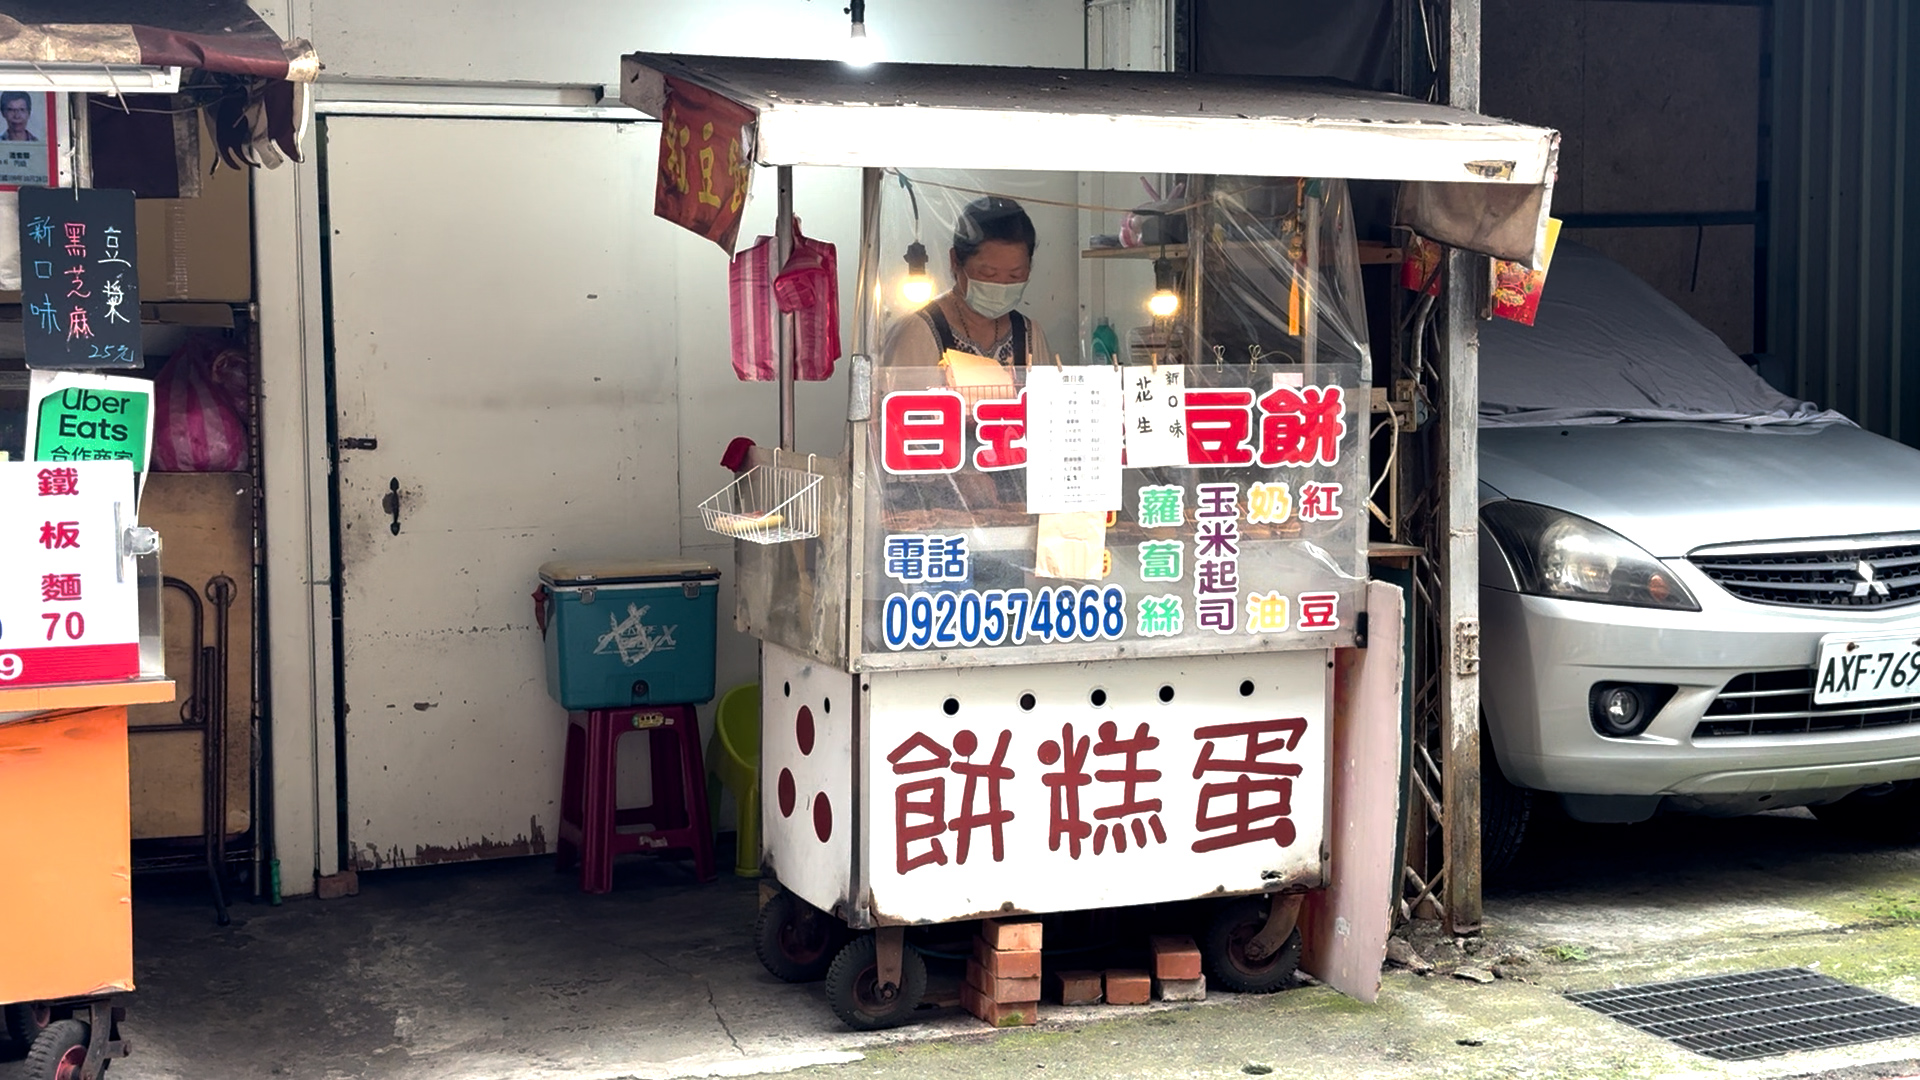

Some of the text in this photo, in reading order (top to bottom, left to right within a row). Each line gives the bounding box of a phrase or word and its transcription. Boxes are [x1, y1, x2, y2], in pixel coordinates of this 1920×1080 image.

[27, 216, 61, 334] 新口味
[64, 223, 95, 342] 黑芝麻
[88, 345, 134, 362] 25元
[58, 414, 129, 442] Eats
[62, 388, 131, 415] Uber
[884, 389, 1344, 469] 日式豆餅
[1135, 376, 1153, 434] 花生
[1165, 371, 1185, 438] 新口味
[37, 467, 82, 602] 鐵板麵
[887, 537, 966, 580] 電話
[1140, 488, 1181, 632] 蘿蔔絲
[1198, 487, 1238, 631] 玉米起司
[1249, 486, 1288, 629] 奶油
[1300, 485, 1339, 627] 紅豆
[41, 612, 85, 641] 70
[886, 588, 1124, 646] 0920574868
